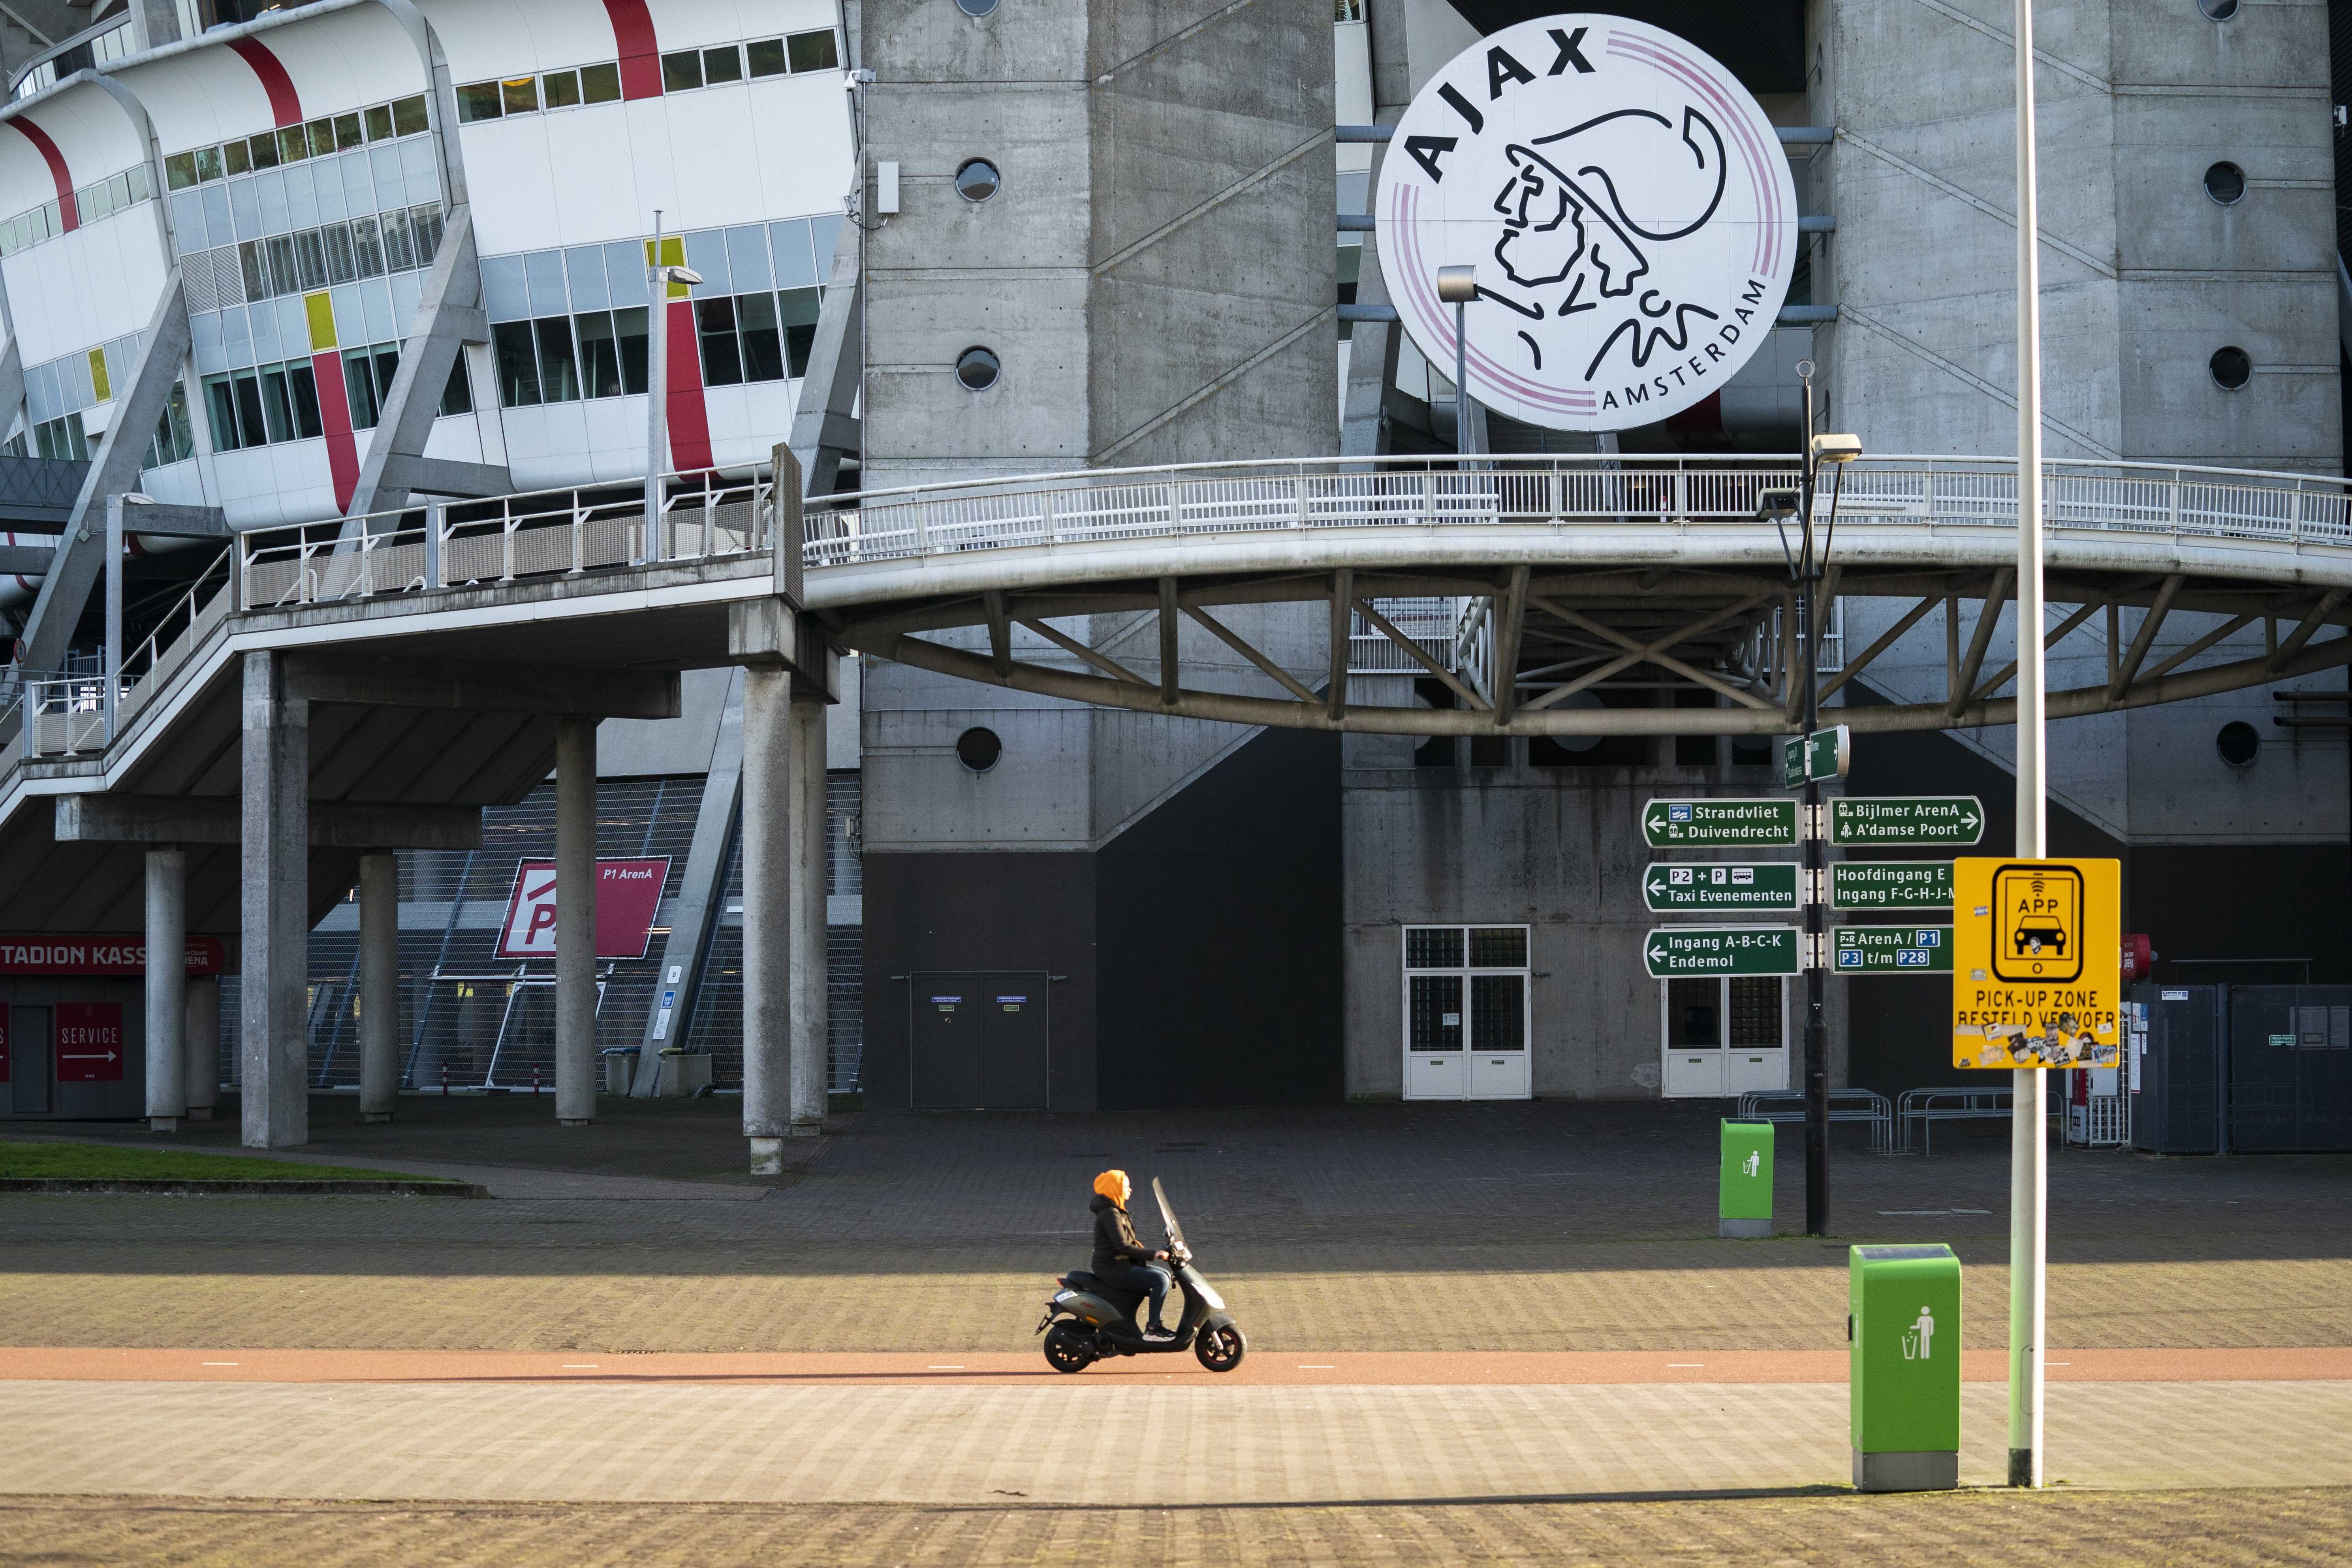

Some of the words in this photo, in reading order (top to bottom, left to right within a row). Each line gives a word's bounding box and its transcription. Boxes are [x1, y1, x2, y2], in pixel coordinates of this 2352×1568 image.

[1404, 27, 1596, 184] AJAX
[1602, 279, 1766, 410] AMSTERDAM
[1788, 765, 1802, 778] Stadionkassa
[1696, 806, 1778, 818] Strandvliet
[1857, 805, 1909, 819] Bijlmer
[1915, 805, 1959, 816] ArenA
[1689, 825, 1788, 837] Duivendrecht
[1857, 824, 1914, 835] A'damse
[1921, 824, 1958, 835] Poort
[604, 869, 616, 879] P1
[619, 869, 652, 879] ArenA
[1716, 871, 1722, 881] P
[1838, 869, 1931, 883] Hoofdingang
[1938, 869, 1944, 880] E
[1668, 890, 1695, 901] Taxi
[1701, 890, 1791, 901] Evenementen
[1838, 889, 1885, 902] Ingang
[2019, 899, 2058, 913] APP
[525, 904, 556, 945] P
[1670, 937, 1719, 951] Ingang
[1726, 935, 1781, 947] A-B-C-K
[1858, 933, 1902, 944] ArenA
[1, 946, 84, 964] TADION
[1670, 955, 1732, 967] Endemol
[1867, 952, 1892, 964] t/m
[1900, 952, 1925, 963] P28
[1977, 991, 2046, 1007] PICK-UP
[2054, 991, 2096, 1007] ZONE
[2039, 1011, 2114, 1028] VEVOER
[62, 1028, 117, 1043] SERVICE
